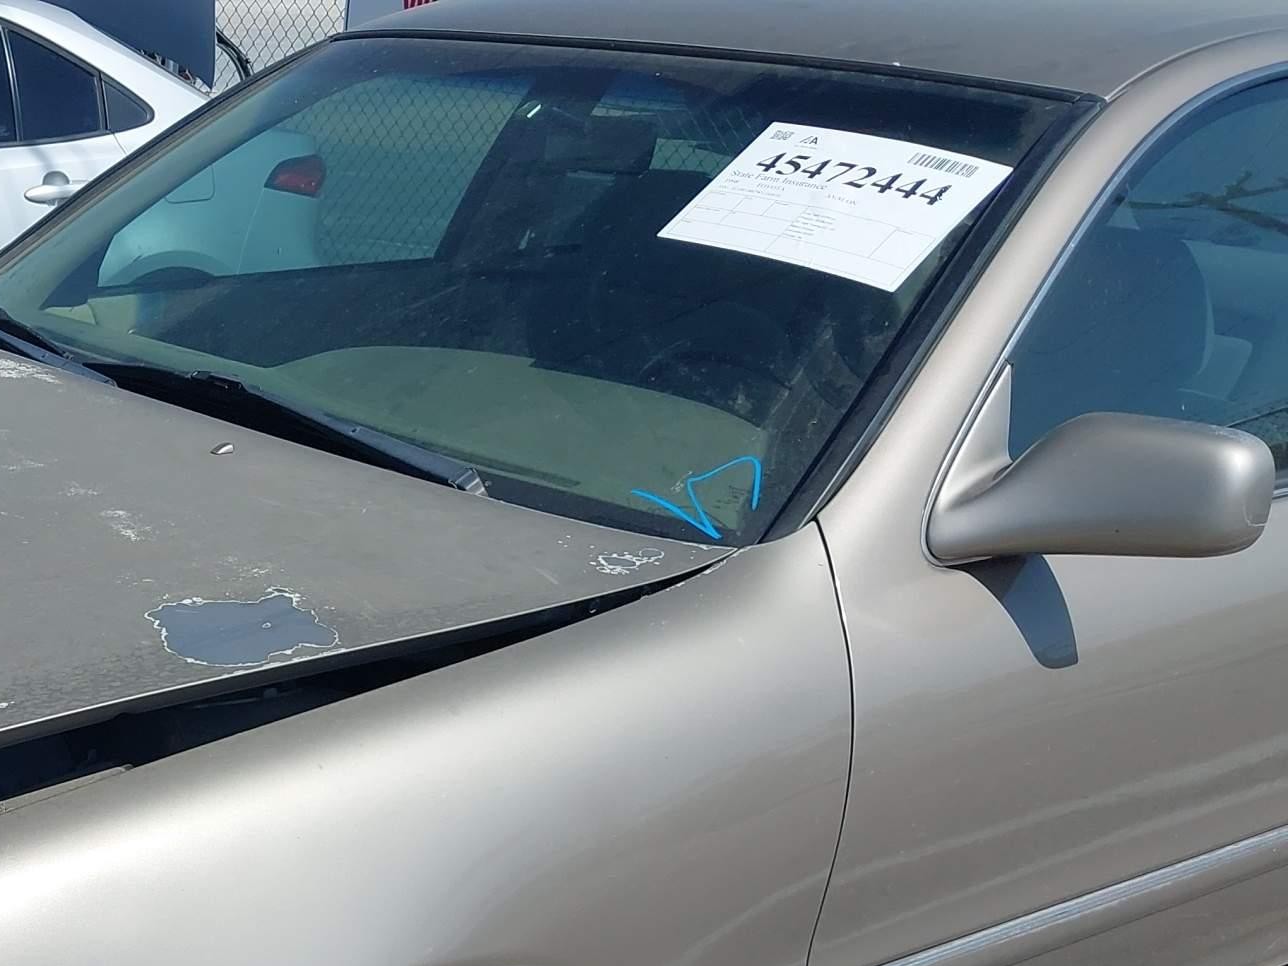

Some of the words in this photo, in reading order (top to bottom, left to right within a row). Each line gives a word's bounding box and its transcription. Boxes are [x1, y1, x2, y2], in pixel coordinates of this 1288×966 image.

[731, 170, 755, 179] State
[754, 173, 781, 183] Farm
[781, 177, 829, 190] Insurance
[756, 152, 953, 206] 45472444
